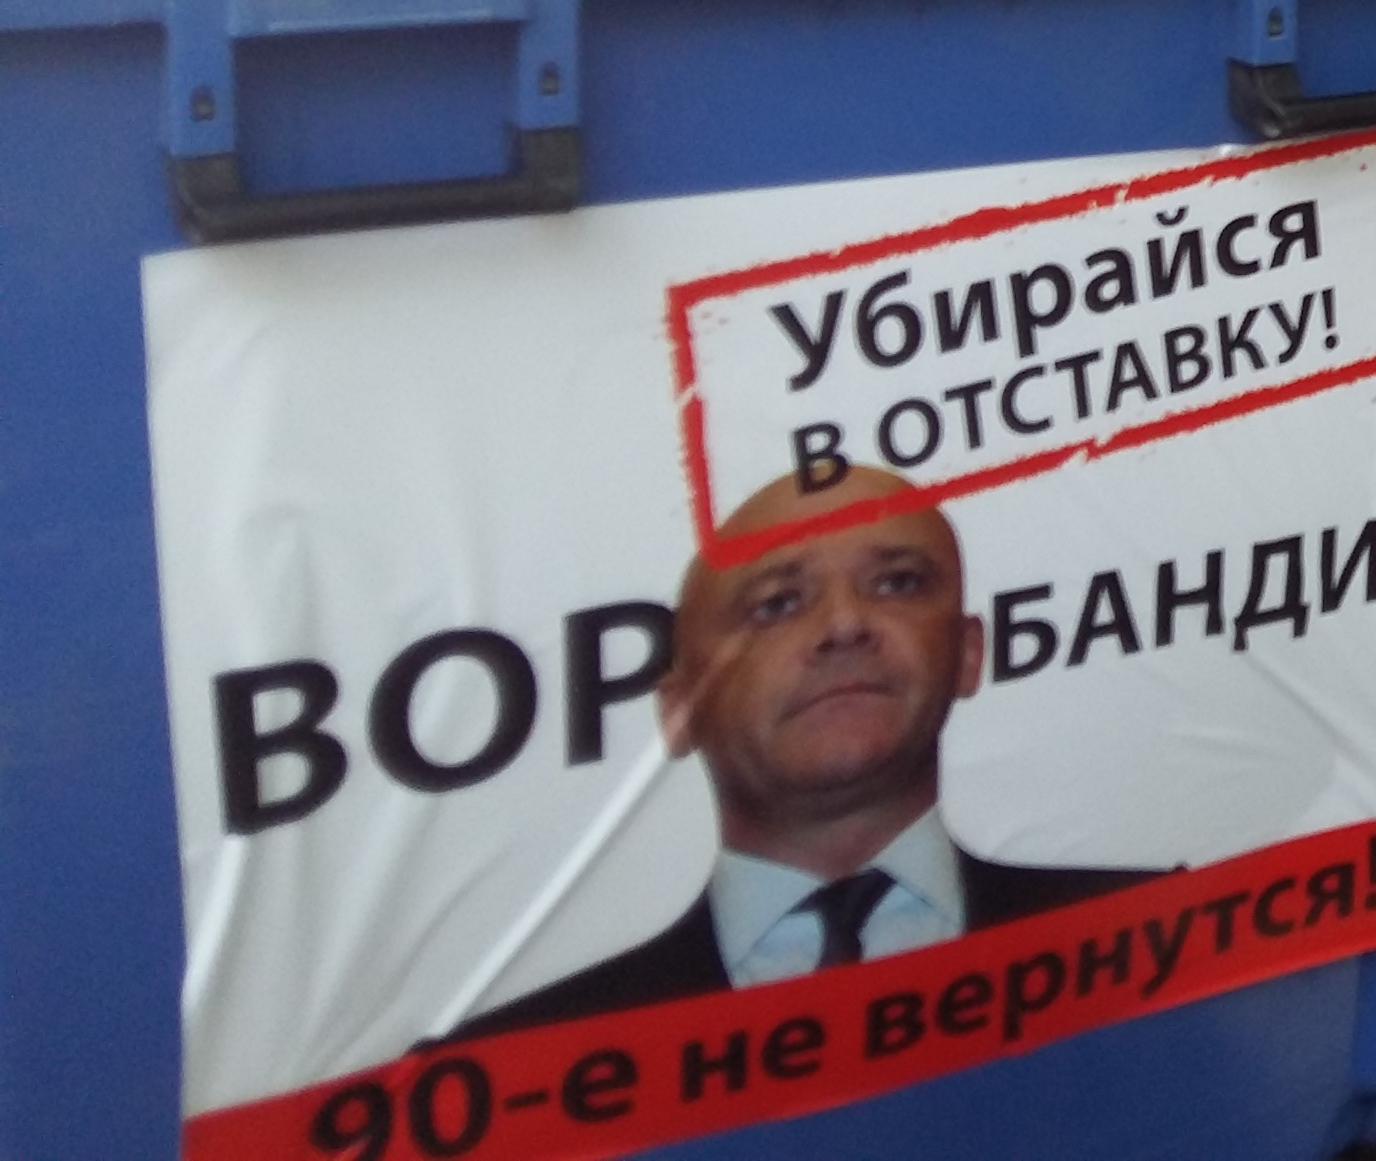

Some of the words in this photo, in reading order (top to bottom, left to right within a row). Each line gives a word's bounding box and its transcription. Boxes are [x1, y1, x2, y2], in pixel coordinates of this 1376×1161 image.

[768, 200, 1322, 392] Убирайся
[875, 288, 1340, 470] ОТСТАВКУ!
[213, 599, 679, 836] ВОР
[309, 1044, 640, 1161] 90-е
[680, 1012, 827, 1102] не
